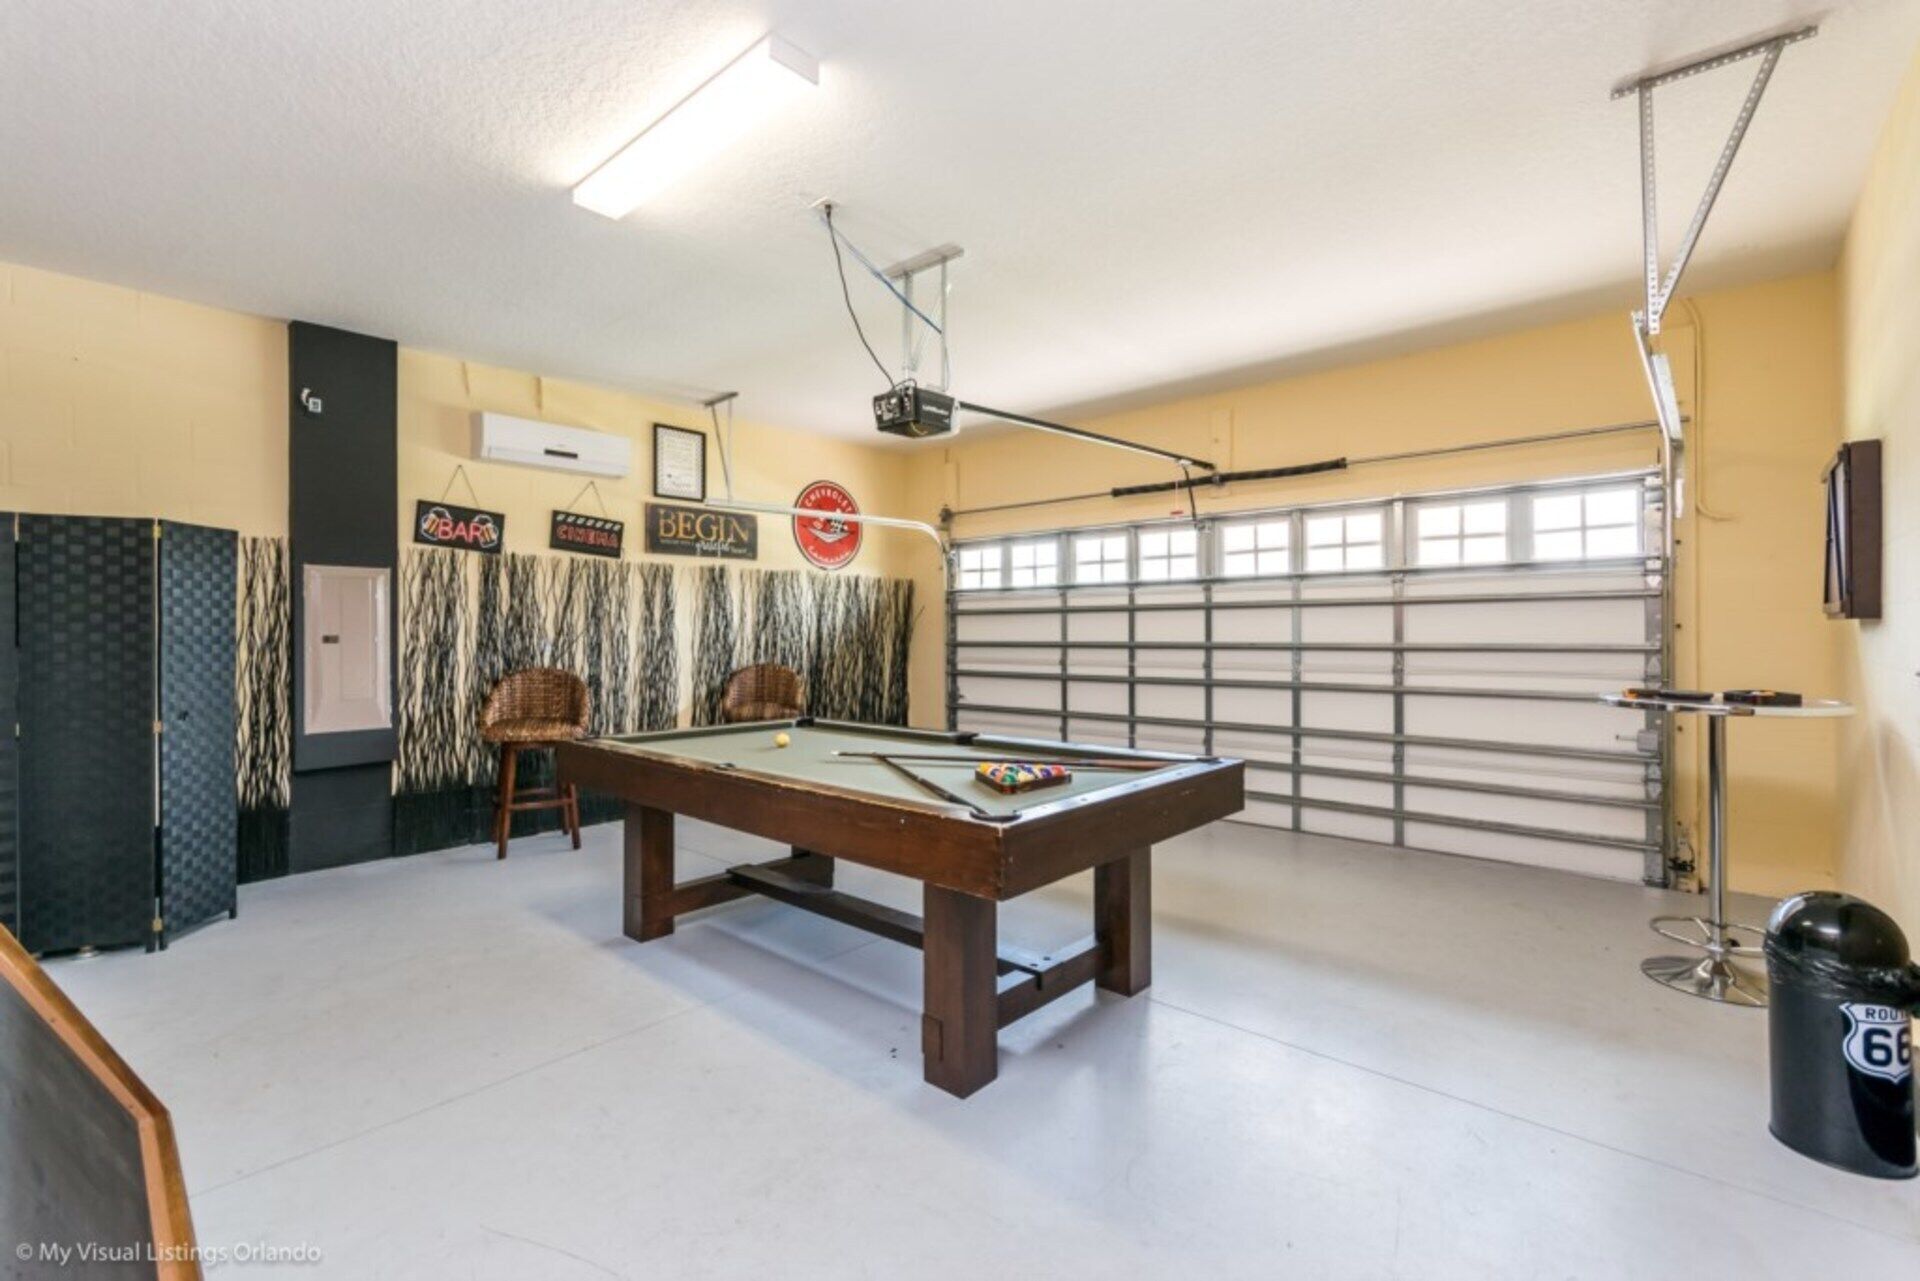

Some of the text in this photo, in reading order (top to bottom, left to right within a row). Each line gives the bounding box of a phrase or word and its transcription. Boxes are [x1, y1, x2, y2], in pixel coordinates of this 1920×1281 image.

[438, 518, 482, 544] BAR
[556, 524, 618, 548] CINEMA
[658, 508, 749, 542] BEGIN
[1863, 1027, 1911, 1067] 66
